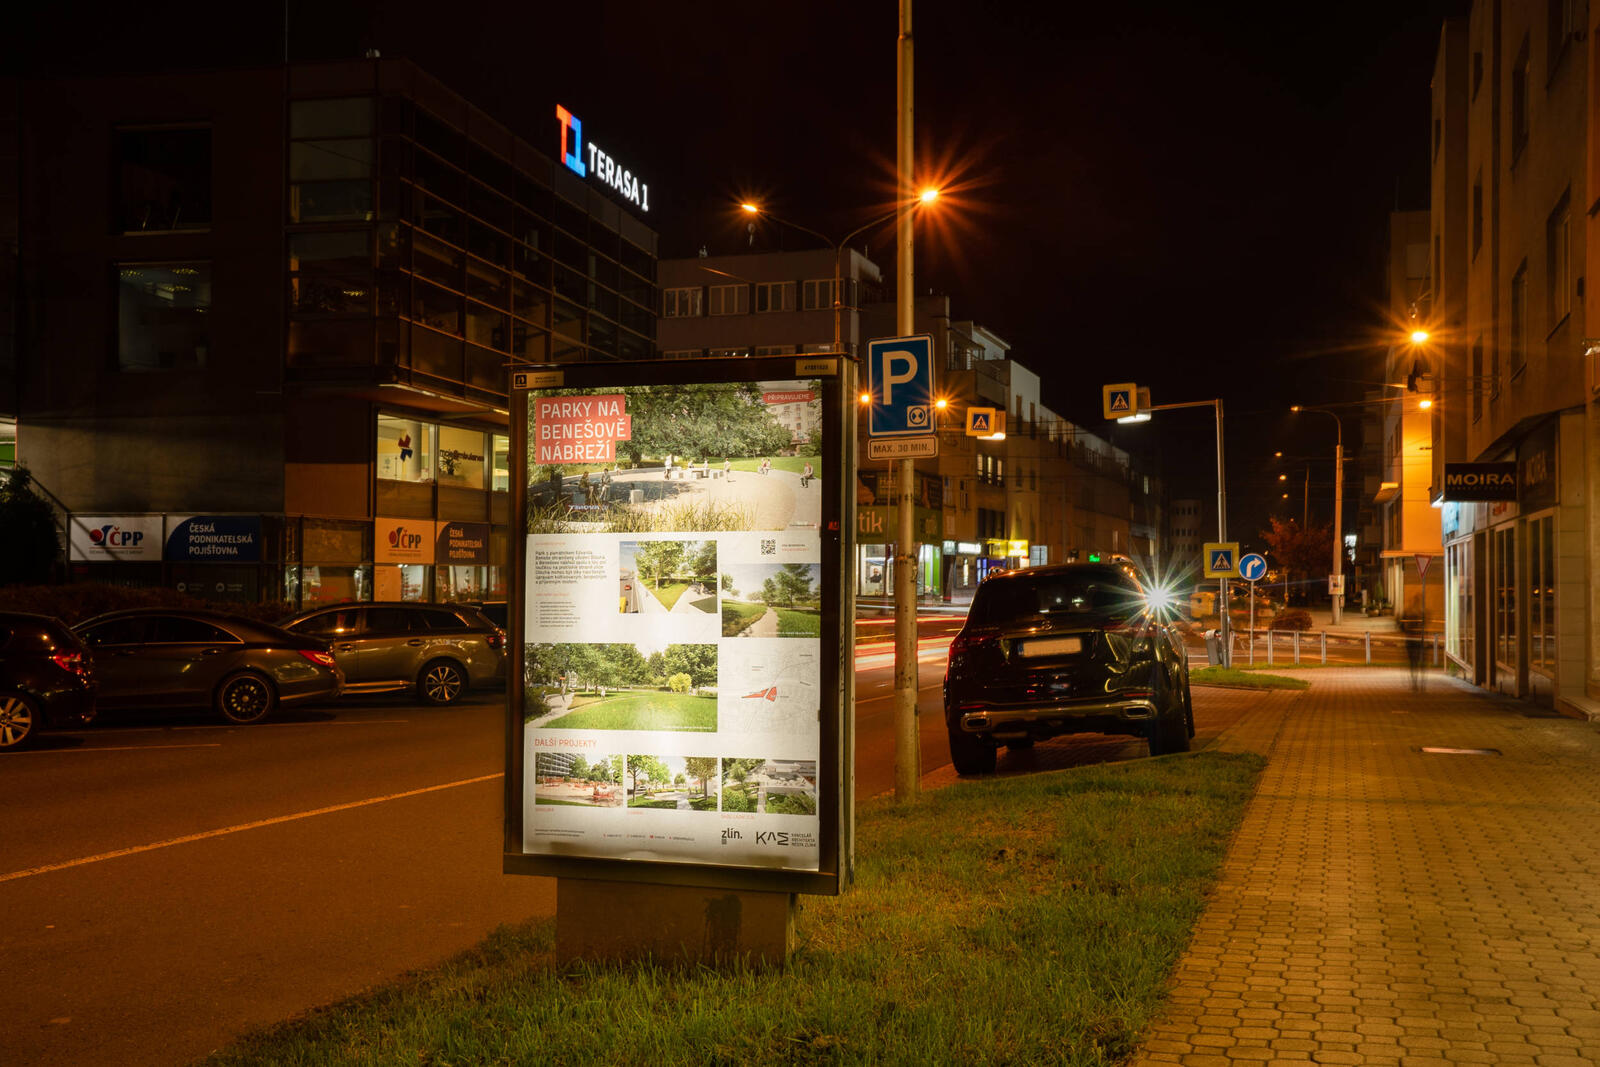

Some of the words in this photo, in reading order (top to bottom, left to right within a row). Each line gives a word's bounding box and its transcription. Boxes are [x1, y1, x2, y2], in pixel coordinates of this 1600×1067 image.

[588, 142, 639, 205] TERASA
[642, 184, 648, 211] 1
[882, 350, 918, 405] P
[541, 401, 592, 419] PARKY
[598, 400, 620, 417] NA
[541, 418, 626, 440] BENEŠOVĚ
[541, 440, 610, 461] NÁBŘEŽÍ
[873, 444, 895, 454] MAX.
[897, 444, 909, 453] 30
[910, 443, 930, 453] MIN.
[1447, 473, 1514, 485] MOIRA
[189, 522, 215, 533] ČESKÁ
[109, 526, 144, 546] ČPP
[189, 533, 253, 544] PODNIKATELSKÁ
[401, 529, 422, 549] ČPP
[188, 545, 238, 556] POJIŠŤOVNA
[534, 737, 556, 747] DALŠÍ
[559, 738, 597, 748] PROJEKTY
[721, 828, 743, 839] zlín.
